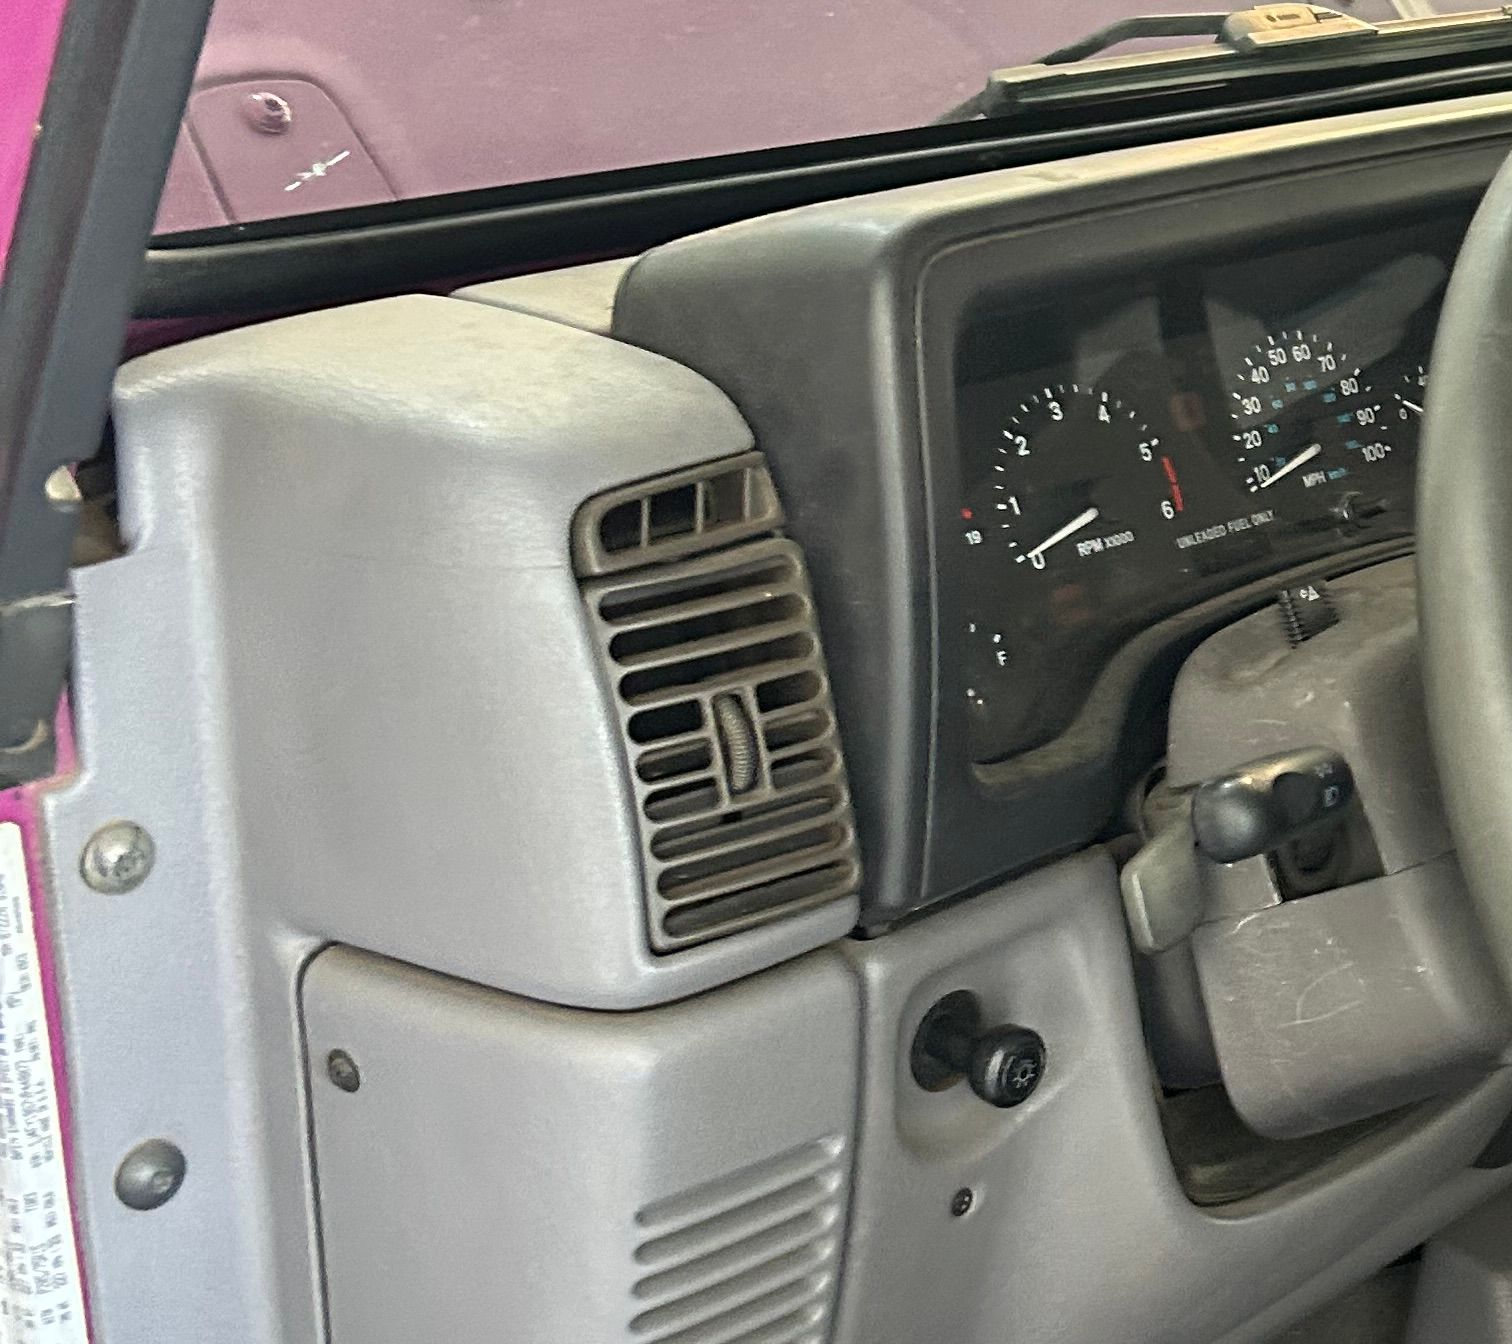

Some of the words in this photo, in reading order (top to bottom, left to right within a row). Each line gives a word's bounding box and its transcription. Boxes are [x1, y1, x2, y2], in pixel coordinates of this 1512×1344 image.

[1267, 348, 1288, 366] 50
[1291, 344, 1311, 362] 60
[1318, 354, 1336, 372] 70
[1251, 366, 1270, 384] 40
[1340, 378, 1359, 396] 80
[1048, 401, 1063, 421] 3
[1098, 404, 1111, 423] 4
[1241, 396, 1261, 415] 30
[1356, 407, 1375, 425] 90
[1014, 436, 1031, 456] 2
[1138, 442, 1152, 461] 5
[1243, 430, 1262, 450] 20
[1362, 442, 1385, 463] 100
[1254, 464, 1271, 482] 10
[1302, 471, 1327, 488] MPH
[1009, 496, 1021, 515] 1
[1161, 500, 1175, 520] 6
[1176, 524, 1227, 549] UNLEADED
[1227, 518, 1252, 533] FUEL
[1251, 509, 1275, 526] ONLY
[1076, 538, 1104, 557] RPM
